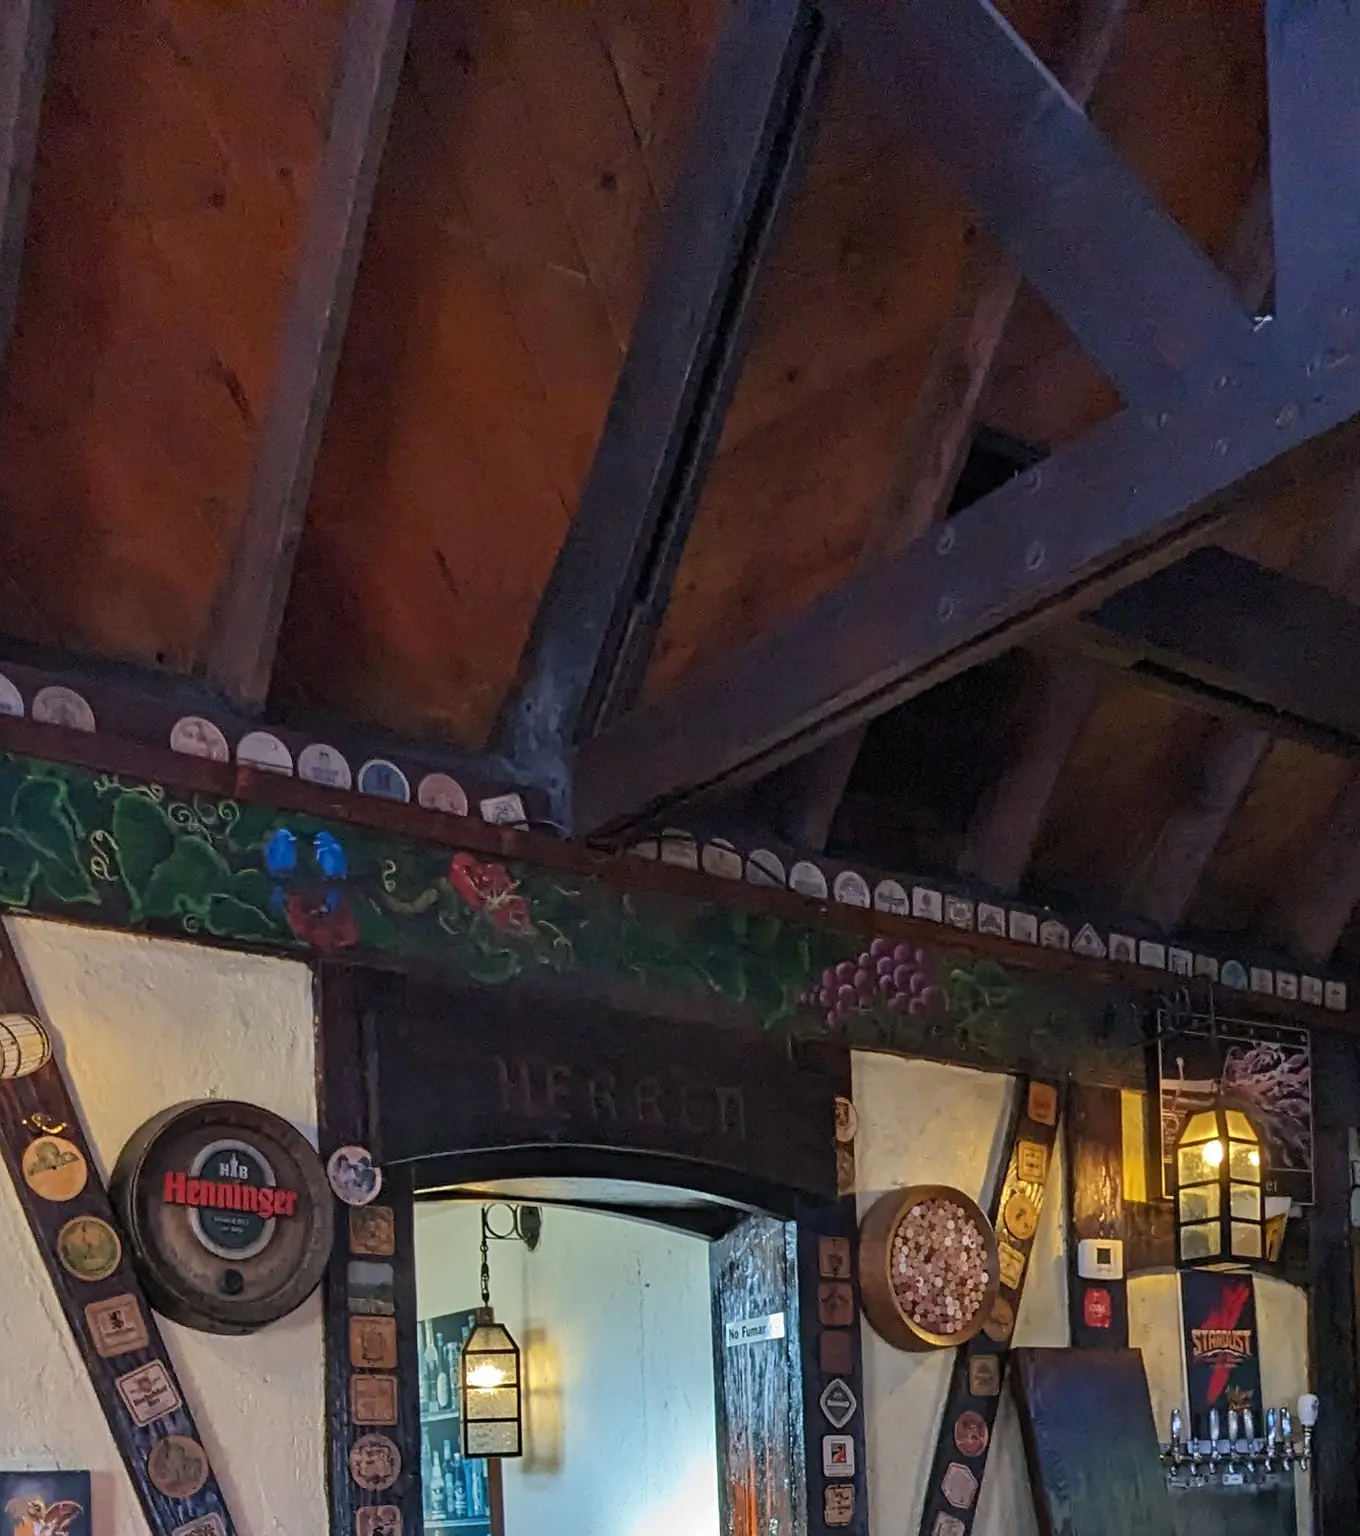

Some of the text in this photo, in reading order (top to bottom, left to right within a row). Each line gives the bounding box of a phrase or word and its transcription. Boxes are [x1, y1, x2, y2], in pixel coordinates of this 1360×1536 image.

[163, 1170, 298, 1220] Henninger
[728, 1324, 767, 1340] No Fumar
[1191, 1328, 1253, 1357] STARDUST
